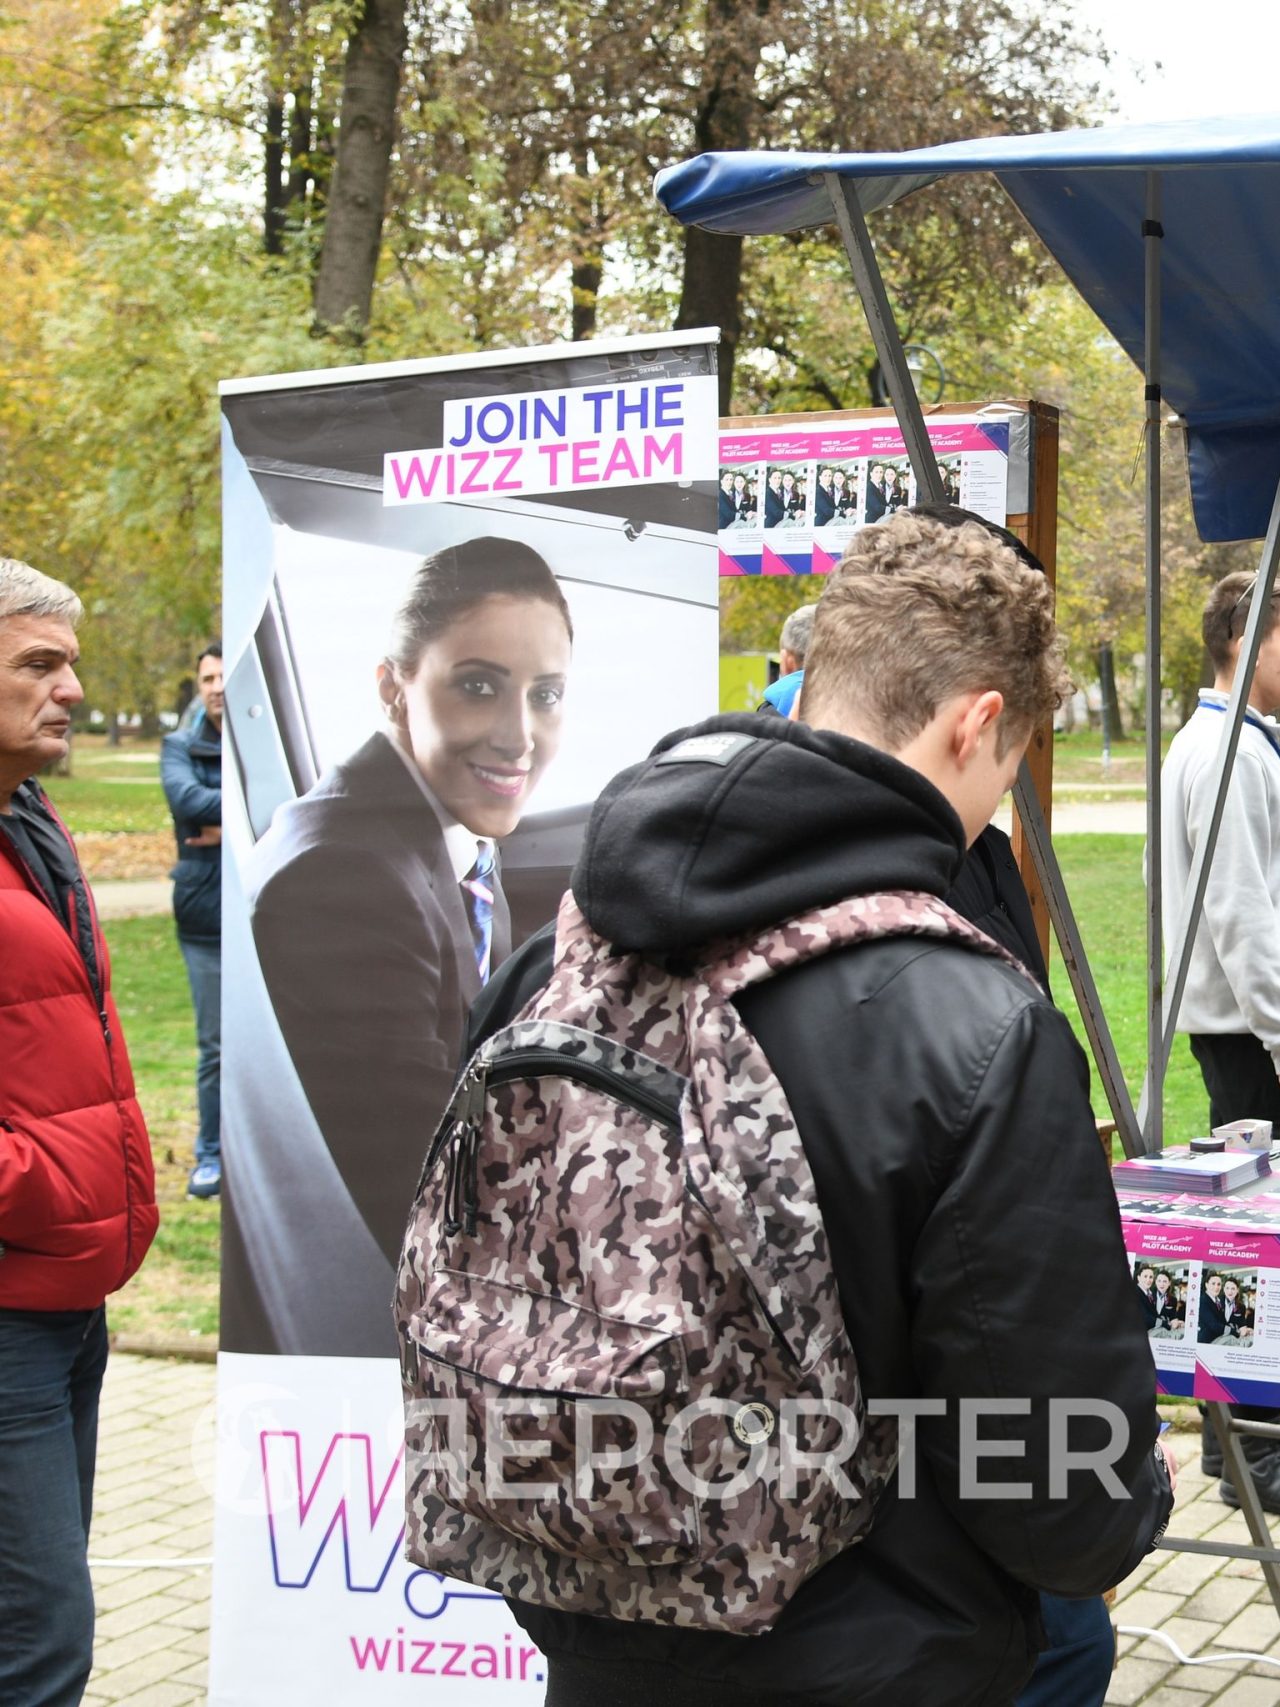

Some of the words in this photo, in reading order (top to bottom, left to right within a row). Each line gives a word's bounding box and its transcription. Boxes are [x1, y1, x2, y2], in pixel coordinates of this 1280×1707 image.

[449, 396, 566, 447] JOIN
[583, 384, 685, 433] THE
[390, 447, 524, 499] WIZZ
[538, 433, 682, 486] TEAM
[1160, 1244, 1192, 1252] ACADEMY
[1228, 1250, 1260, 1259] ACADEMY
